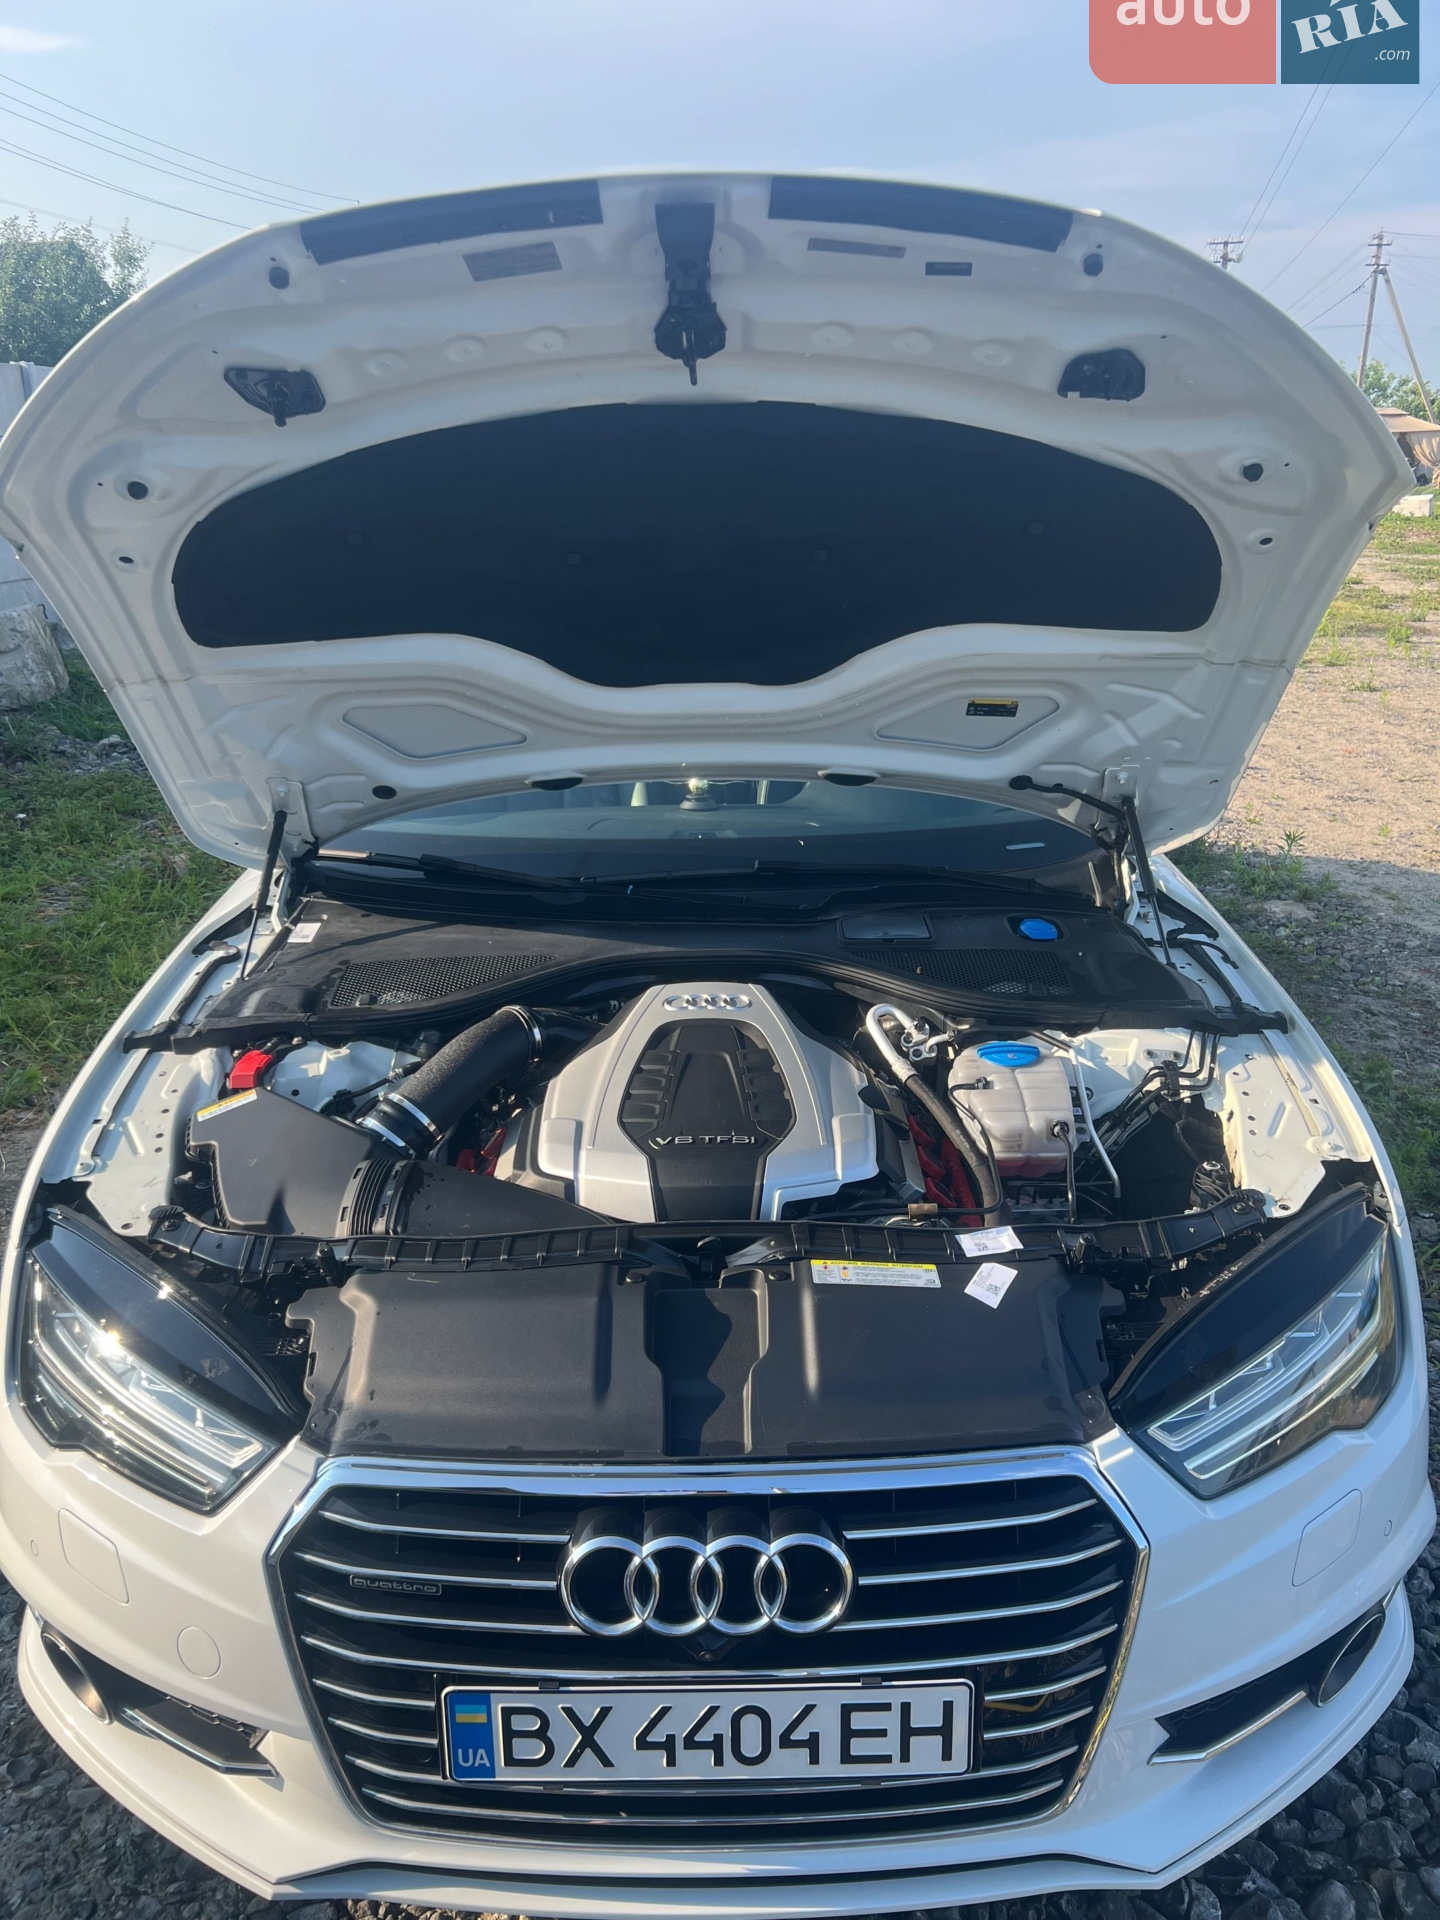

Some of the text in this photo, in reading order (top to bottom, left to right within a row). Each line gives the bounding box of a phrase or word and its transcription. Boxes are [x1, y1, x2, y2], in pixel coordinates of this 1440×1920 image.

[655, 1135, 755, 1145] V6 TFSI
[354, 1578, 437, 1592] quattro
[499, 1699, 954, 1768] BX 4404 EH
[457, 1748, 491, 1767] UA
